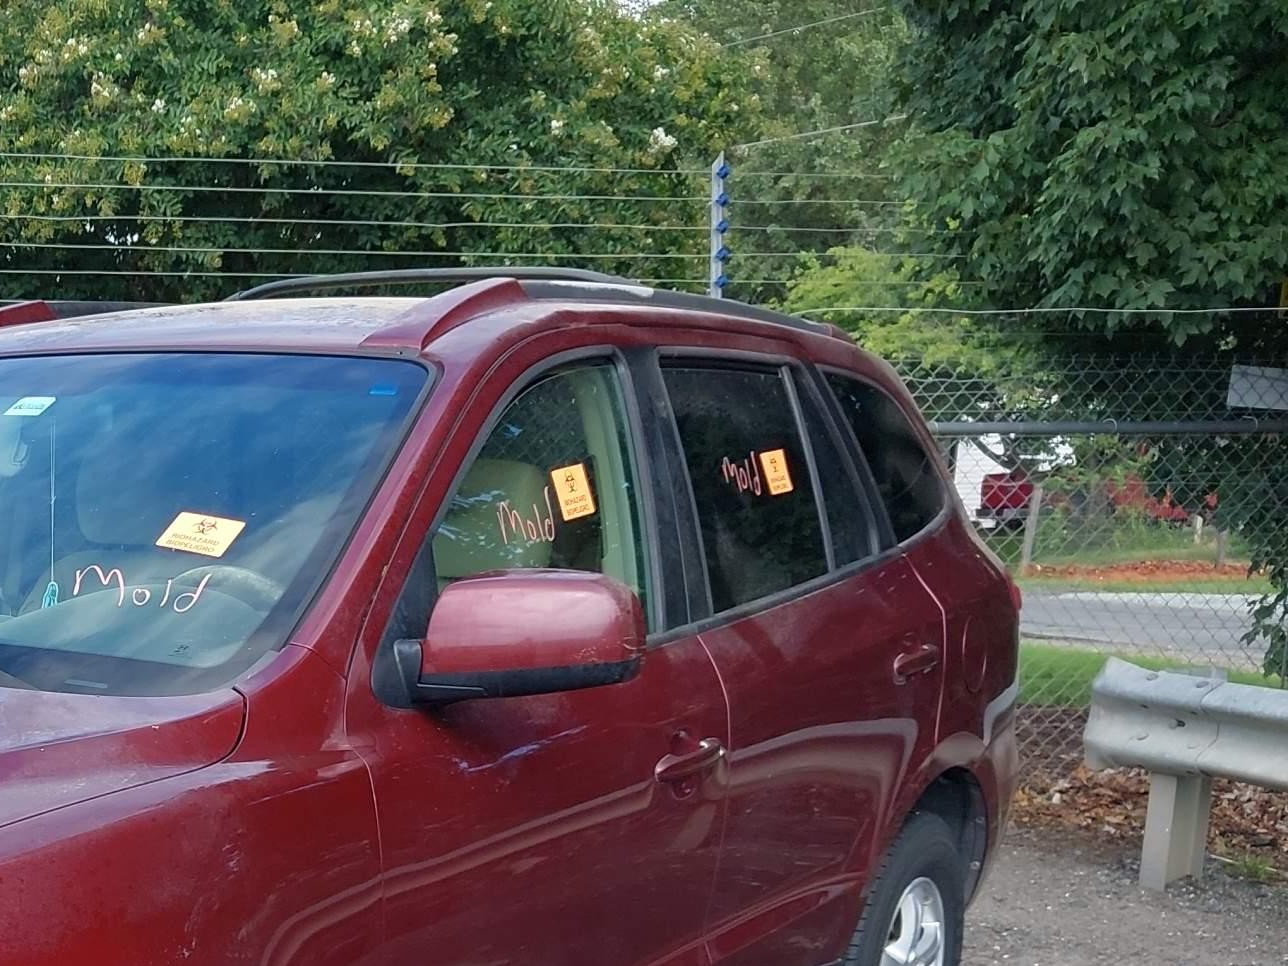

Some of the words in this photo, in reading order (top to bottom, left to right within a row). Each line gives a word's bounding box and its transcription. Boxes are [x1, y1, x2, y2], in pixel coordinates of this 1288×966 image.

[721, 450, 761, 496] Mold
[496, 486, 555, 545] Mold
[166, 539, 216, 553] BIOPELIGRO
[171, 532, 220, 546] BIOHAZARD
[72, 565, 213, 613] Mold
